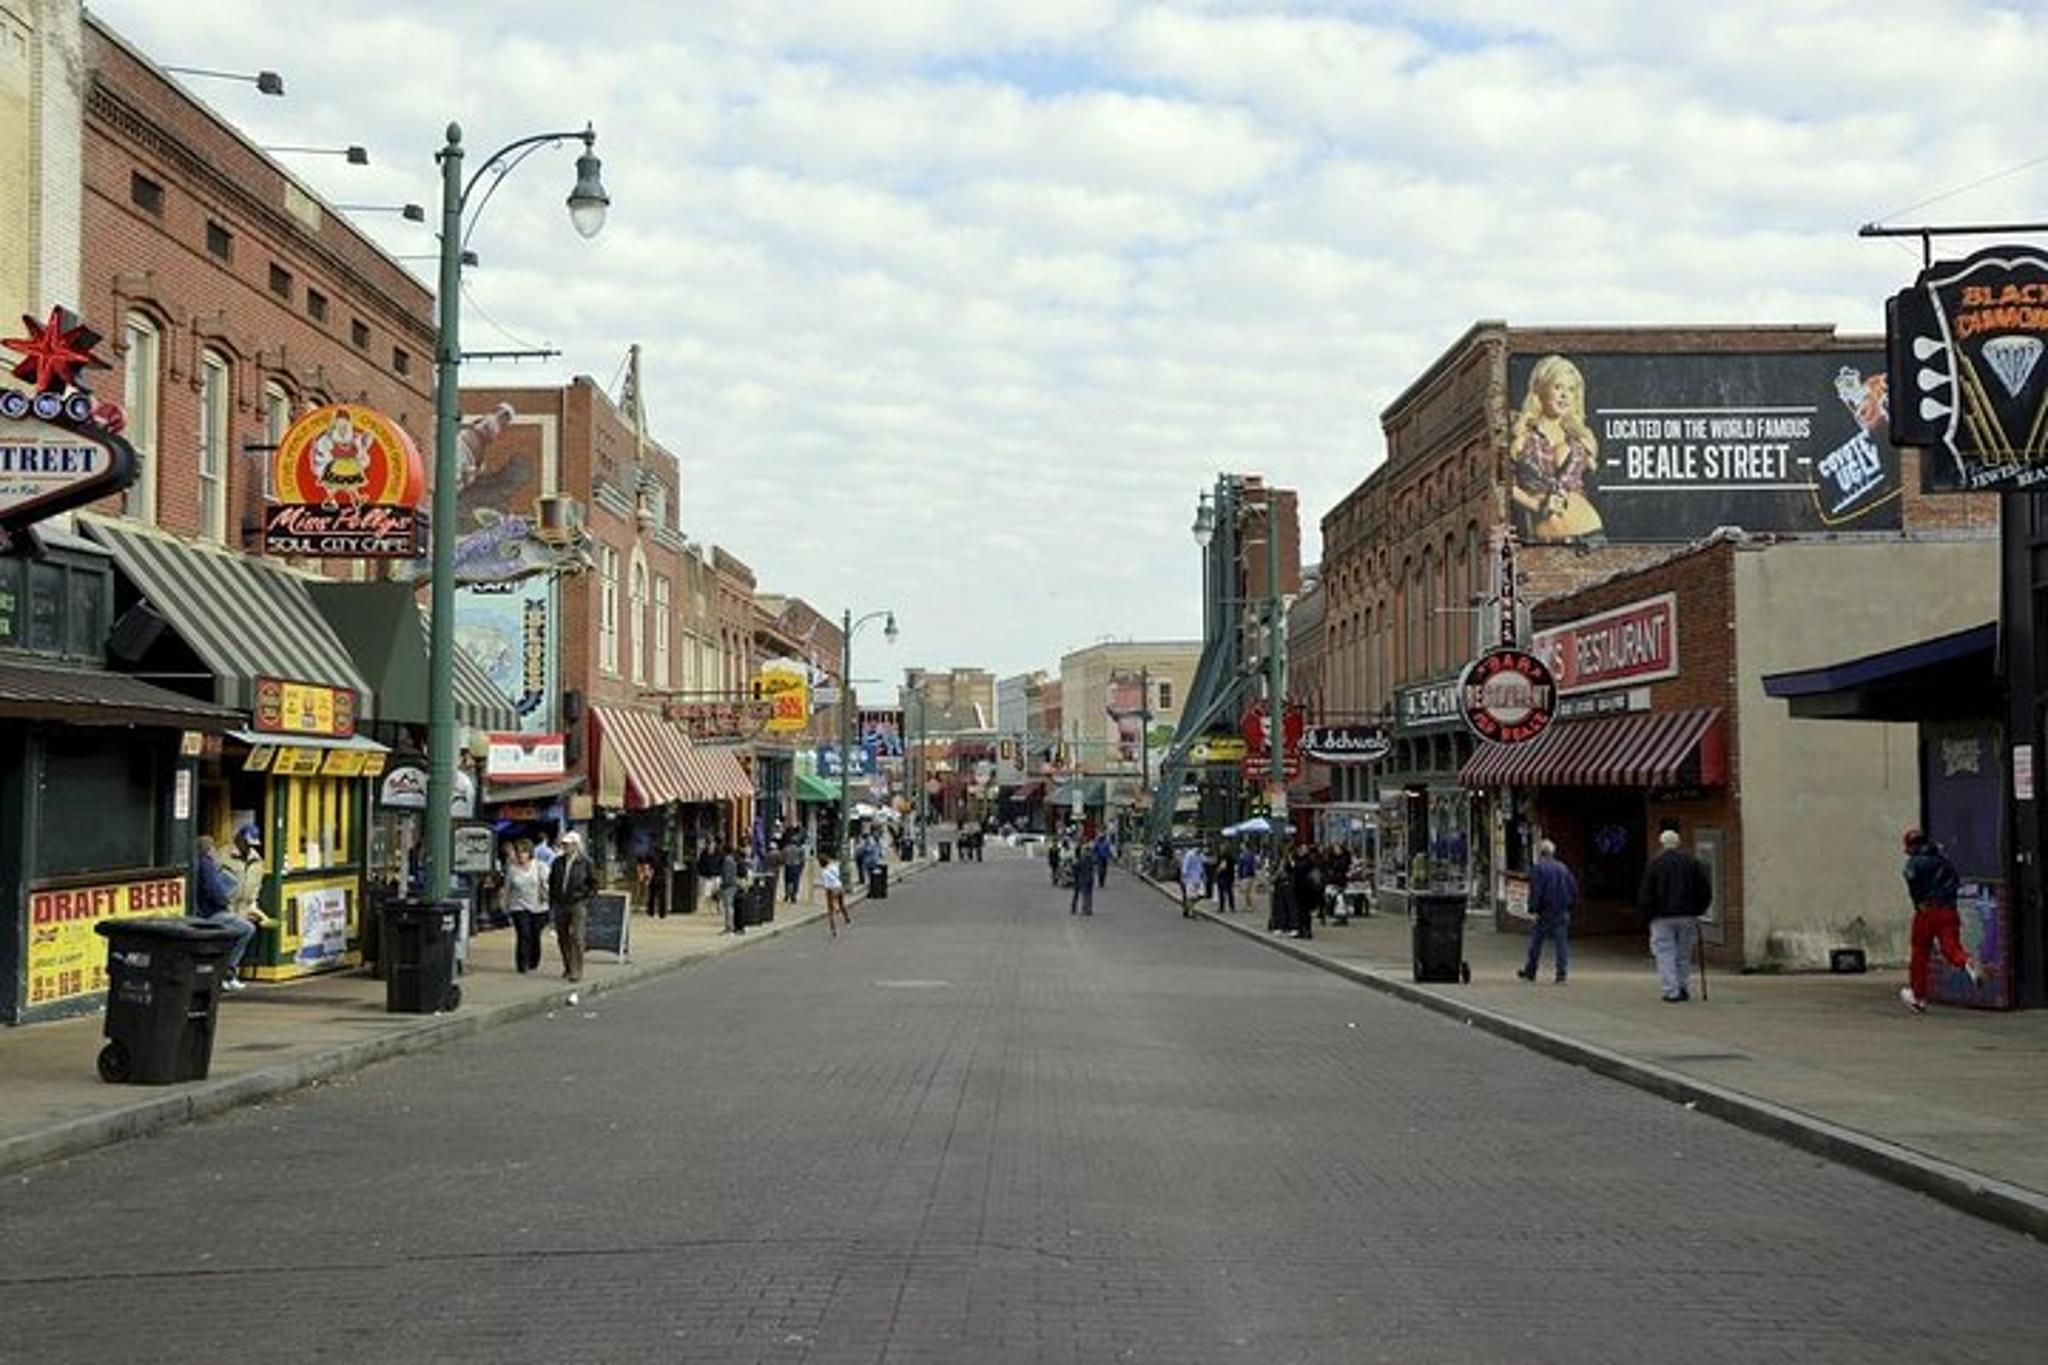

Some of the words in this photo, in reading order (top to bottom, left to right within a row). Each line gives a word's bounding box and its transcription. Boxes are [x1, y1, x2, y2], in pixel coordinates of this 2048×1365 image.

[1606, 419, 1661, 439] LOCATED
[1664, 419, 1682, 438] ON
[1684, 419, 1707, 438] THE
[1709, 418, 1755, 438] WORLD
[1757, 417, 1811, 438] FAMOUS
[1627, 446, 1698, 479] BEALE
[1703, 444, 1789, 479] STREET
[1836, 443, 1881, 491] UGLY
[267, 537, 318, 552] SOUL
[320, 537, 360, 551] CITY
[1577, 615, 1665, 674] RESTAURANT
[33, 887, 118, 925] DRAFT
[127, 881, 181, 911] BEER
